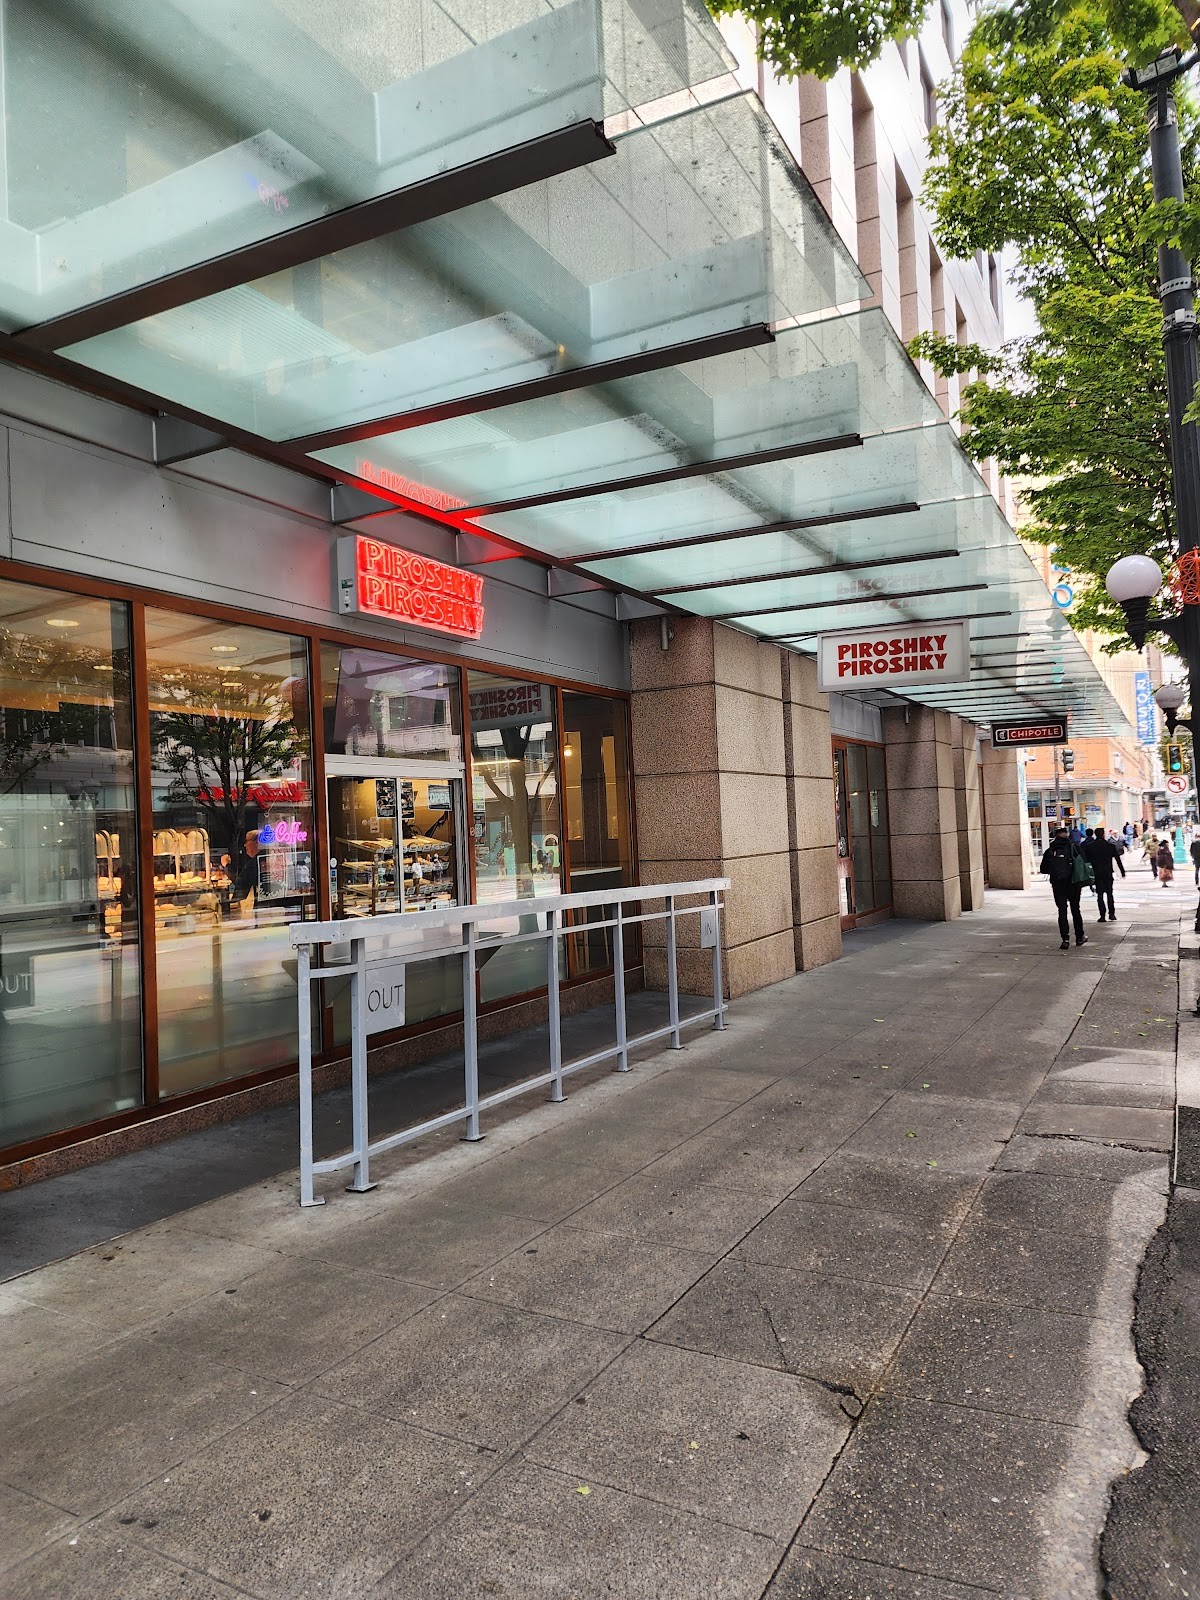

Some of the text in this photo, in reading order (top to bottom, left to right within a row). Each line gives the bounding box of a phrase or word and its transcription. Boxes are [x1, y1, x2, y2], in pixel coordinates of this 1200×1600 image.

[363, 539, 484, 603] PIROSHKY
[364, 575, 485, 633] PIROSHKY
[837, 634, 948, 660] PIROSHKY
[837, 653, 948, 677] PIROSHKY
[1011, 728, 1060, 739] CHIPOTLE
[275, 821, 308, 845] Coffee
[367, 985, 404, 1013] OUT
